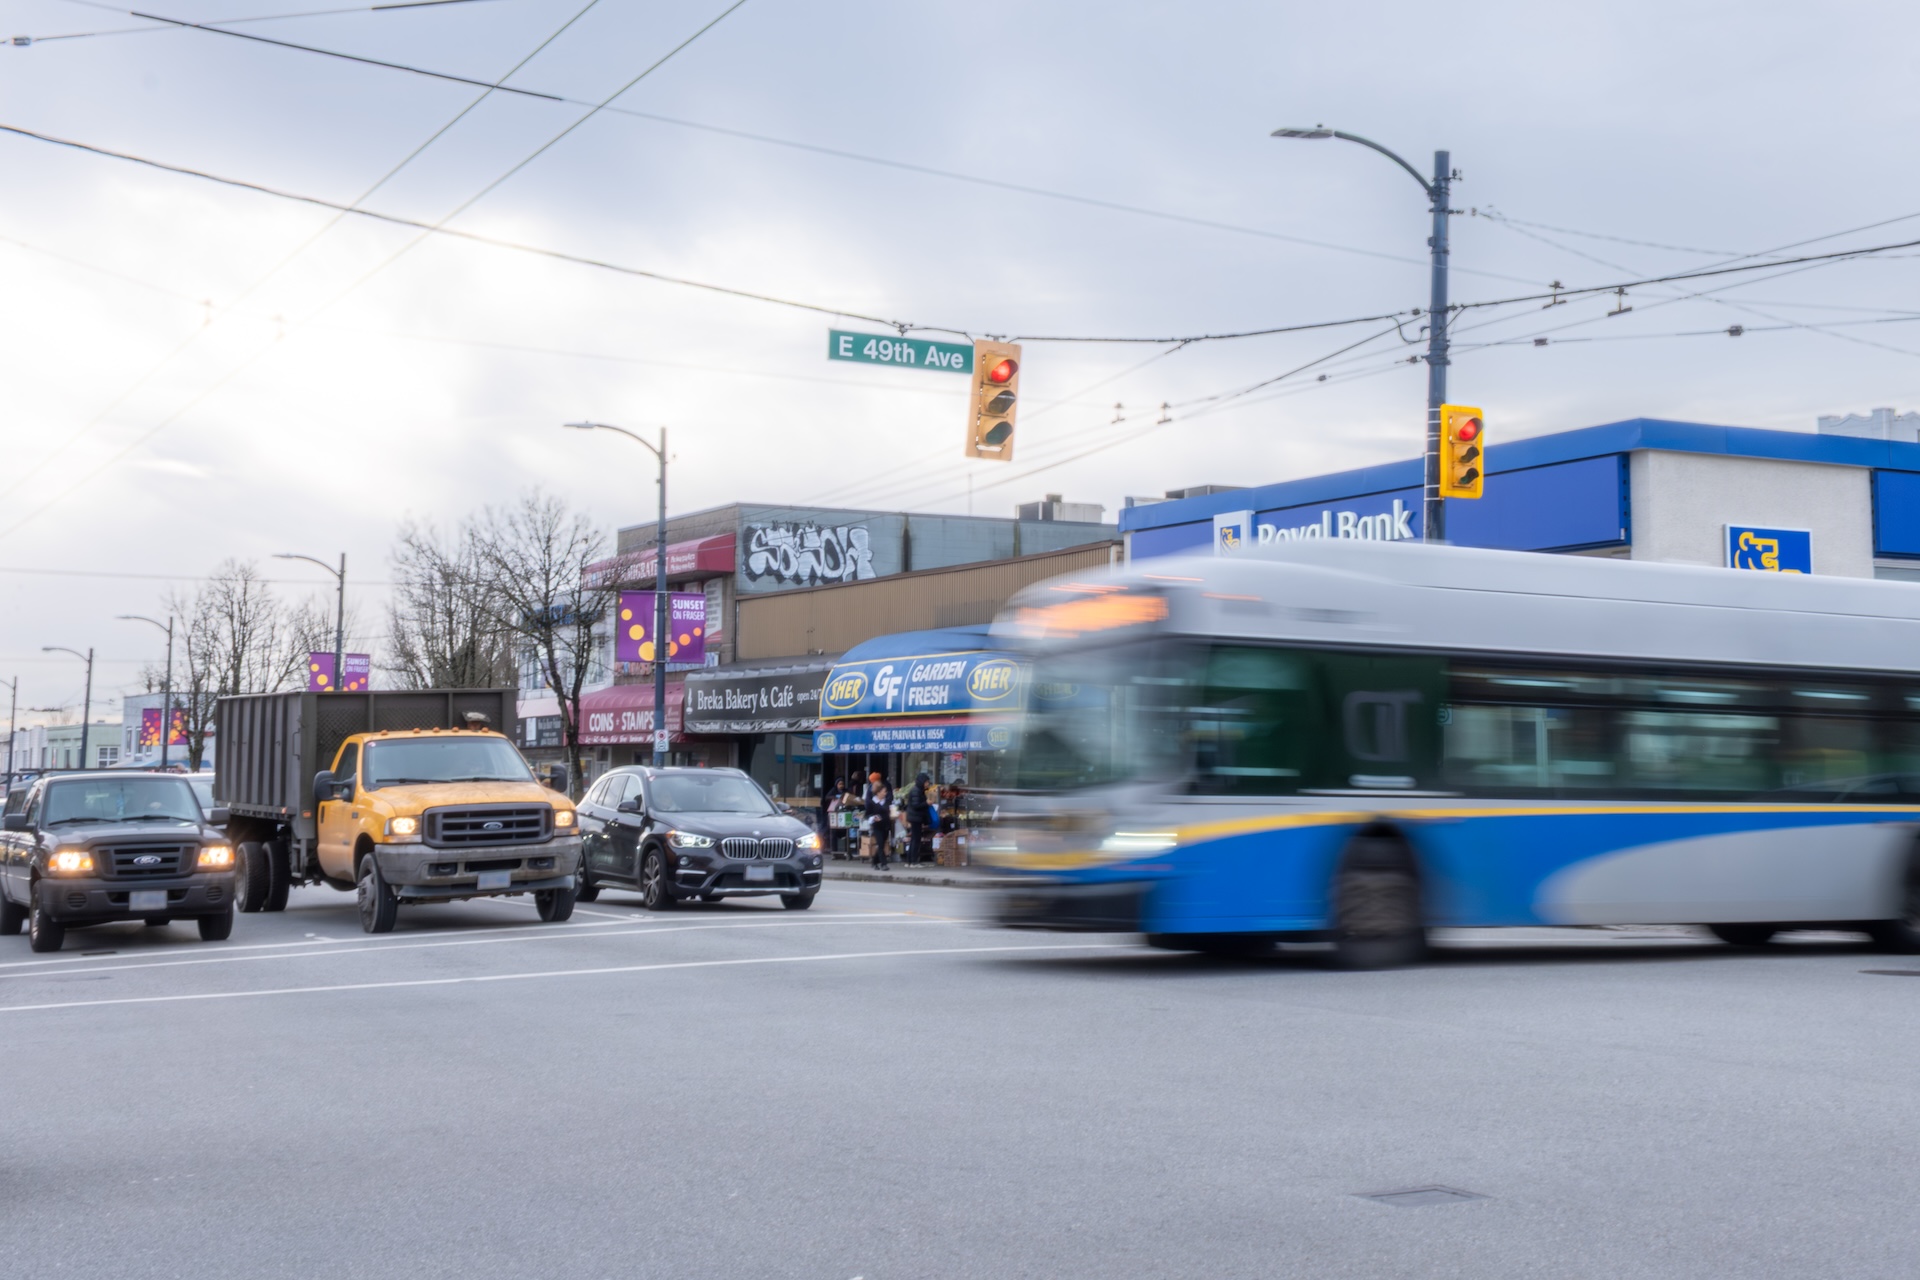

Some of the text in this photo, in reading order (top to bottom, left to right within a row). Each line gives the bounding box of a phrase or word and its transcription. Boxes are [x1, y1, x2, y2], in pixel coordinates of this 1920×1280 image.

[839, 335, 964, 369] E 49th Ave
[1337, 499, 1414, 541] Bank
[672, 599, 705, 610] SUNSET
[672, 611, 705, 621] ON FRASER
[912, 661, 967, 683] GARDEN
[971, 667, 1011, 692] SHER
[697, 689, 724, 710] Breka
[725, 688, 758, 714] Bakery
[760, 687, 768, 709] &
[770, 685, 794, 708] Café
[796, 690, 810, 704] open
[829, 677, 864, 702] SHER
[873, 664, 902, 710] GF
[908, 684, 949, 707] FRESH
[588, 712, 614, 732] COINS
[621, 710, 655, 731] STAMPS
